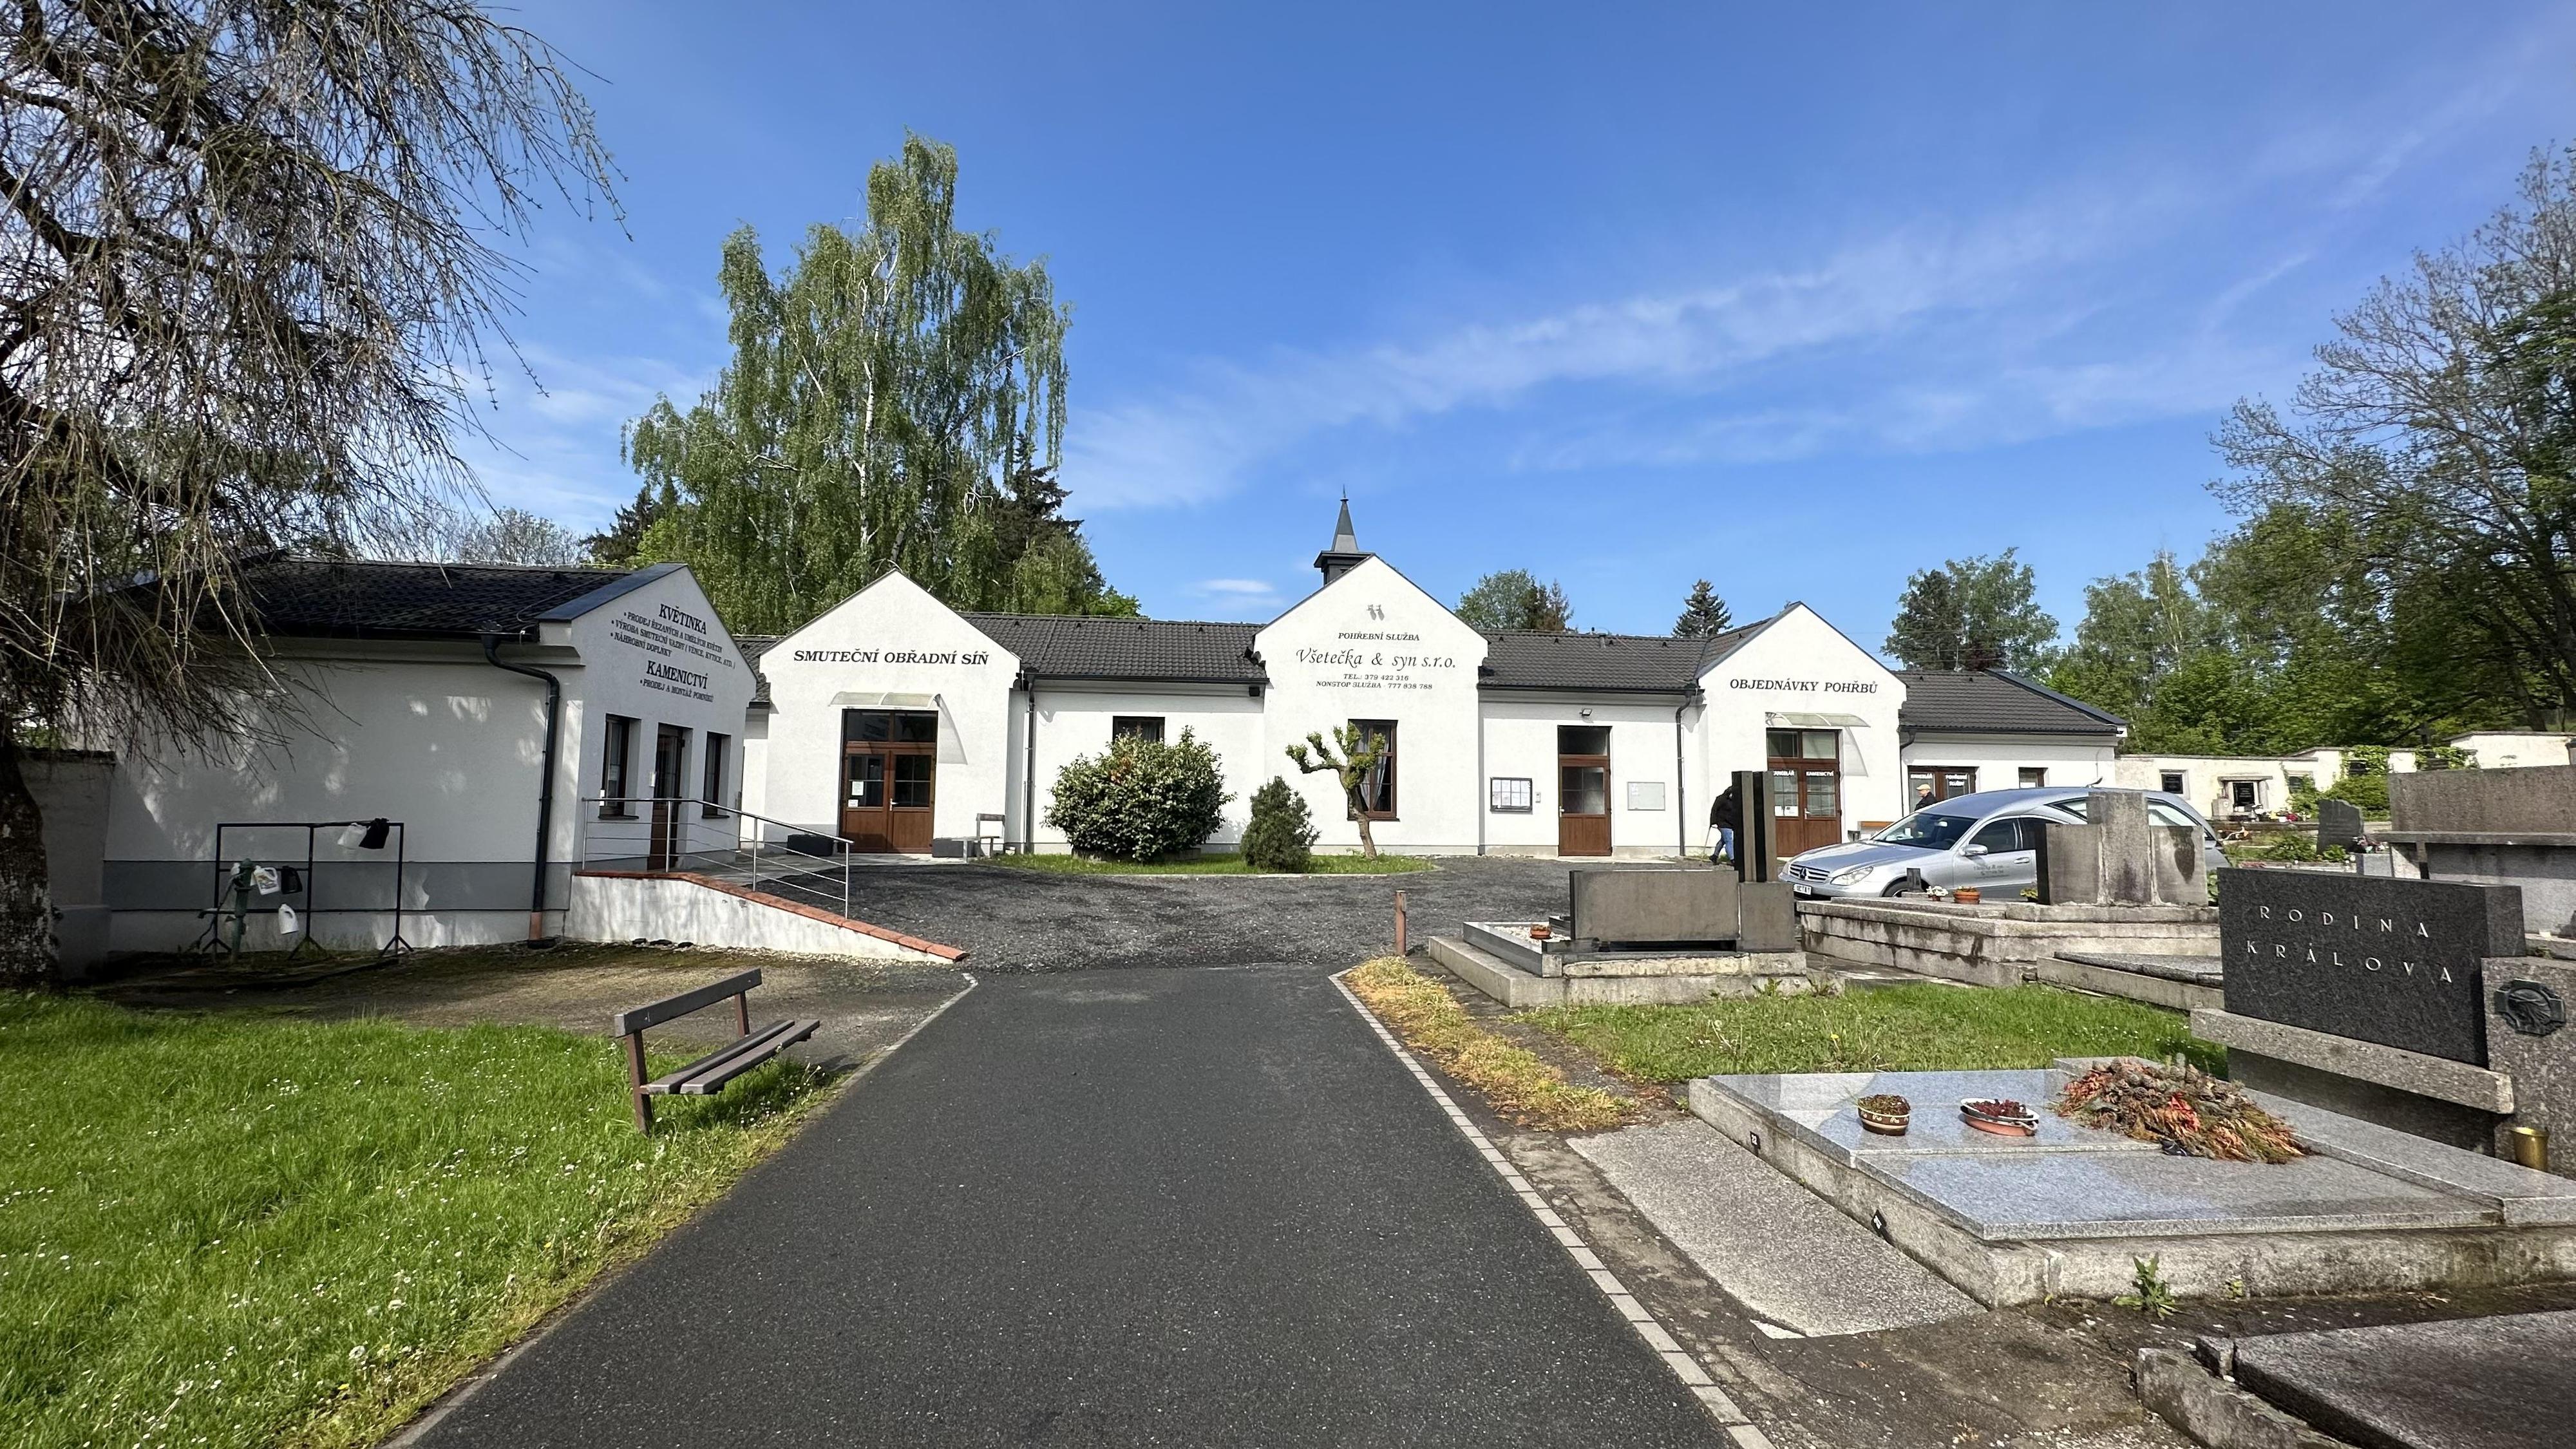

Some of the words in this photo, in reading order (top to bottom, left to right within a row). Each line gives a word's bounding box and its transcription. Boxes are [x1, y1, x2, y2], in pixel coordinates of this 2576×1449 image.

[627, 611, 651, 627] PRODEJ
[651, 619, 679, 638] ŘEZANÝCH
[659, 603, 706, 634] KVĚTINKA
[614, 632, 645, 649] NÁHROBNÍ
[646, 643, 672, 657] DOPLŇKY
[616, 619, 639, 634] VÝROBA
[640, 628, 668, 645] SMUTEČNÍ
[1338, 630, 1384, 640] POHŘEBNÍ
[1386, 632, 1420, 641] SLUŽBA
[793, 648, 880, 663] SMUTEČNÍ
[884, 650, 957, 665] OBŘADNÍ
[961, 650, 989, 665] SÍŇ
[1296, 647, 1363, 668] Všetečka
[1370, 652, 1383, 666] &
[1392, 654, 1417, 671] syn
[1421, 656, 1456, 668] s.r.o.
[646, 659, 708, 689] KAMENICTVÍ
[1730, 677, 1819, 692] OBJEDNÁVKY
[1824, 679, 1879, 694] POHŘBŮ
[643, 678, 665, 691] PRODEJ
[671, 686, 692, 697] MONTÁŽ
[2259, 905, 2429, 938] RODINA
[2246, 940, 2452, 984] KRÁLOVA
